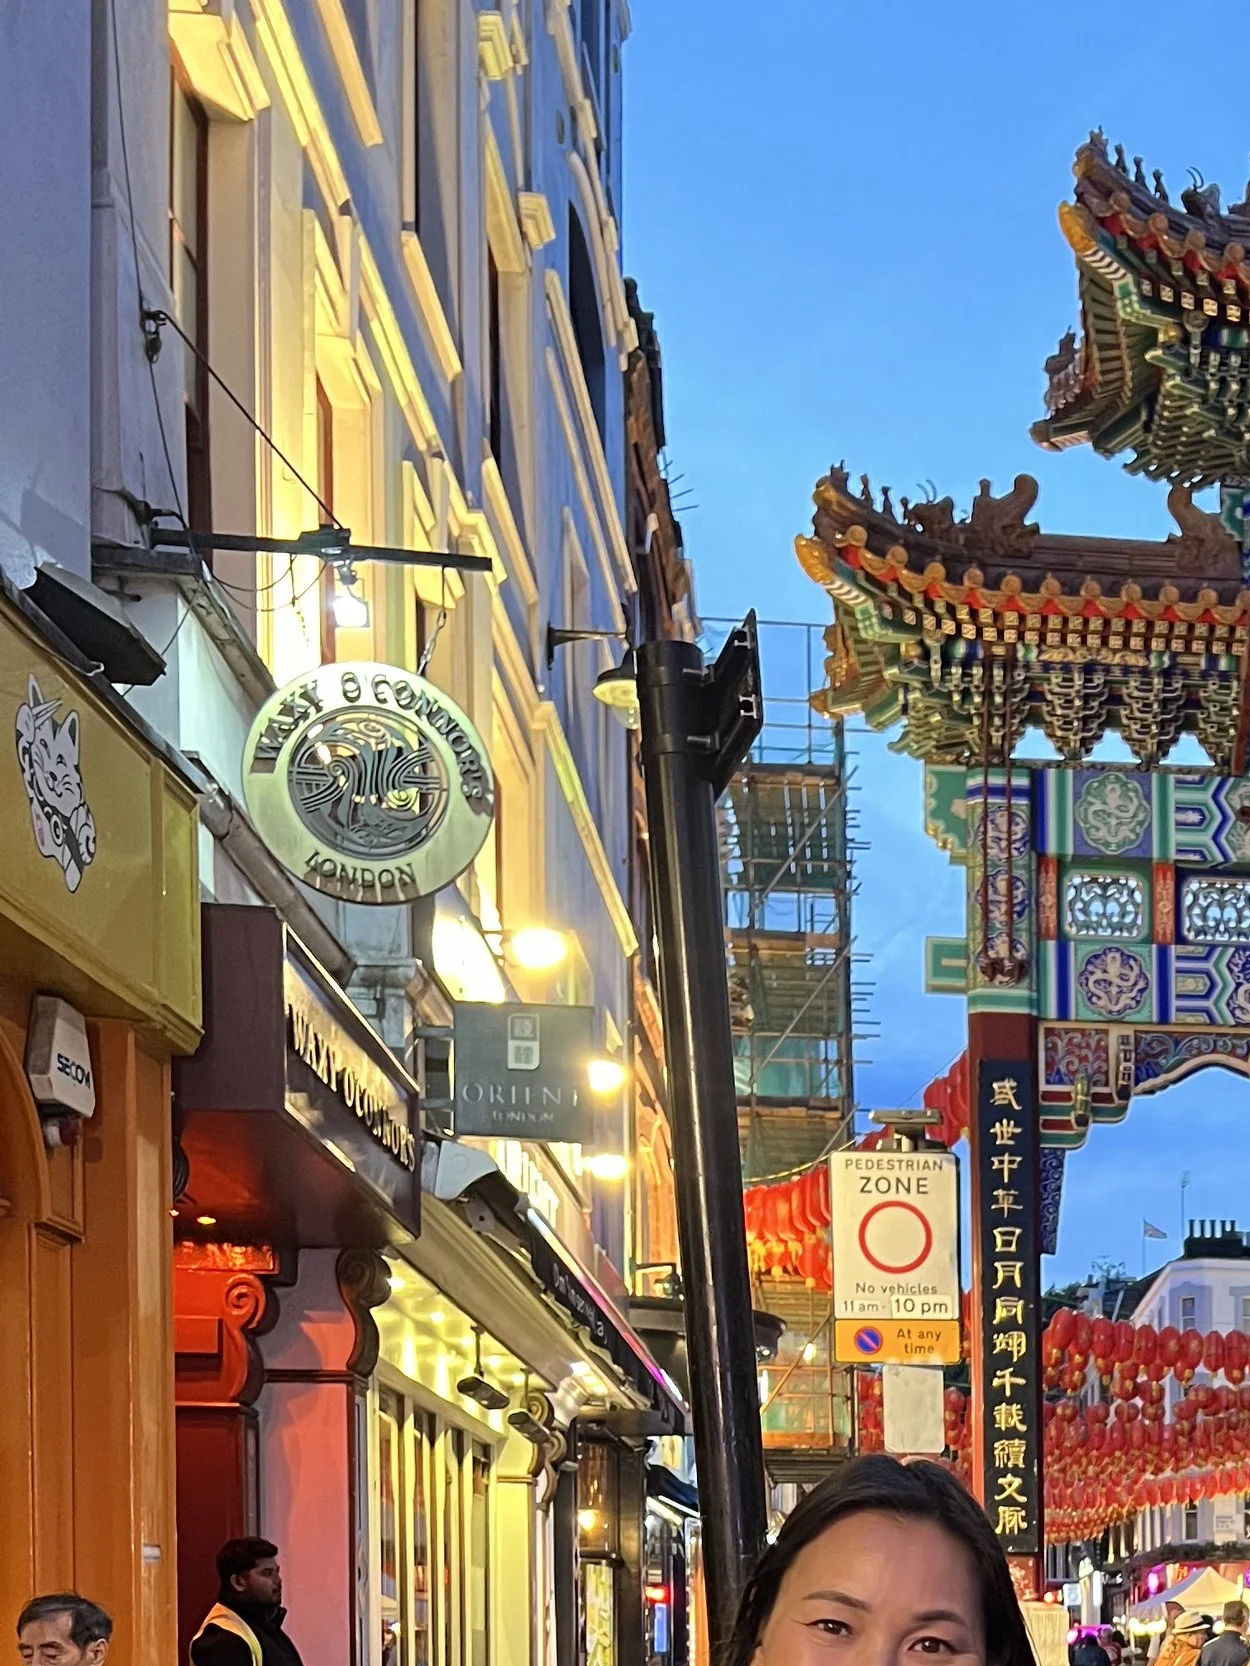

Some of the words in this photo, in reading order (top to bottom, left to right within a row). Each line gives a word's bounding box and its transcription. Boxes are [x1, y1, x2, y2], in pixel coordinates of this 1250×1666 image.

[254, 679, 324, 759] WAXY
[304, 849, 416, 889] LONDON
[845, 1158, 943, 1172] PEDESTRIAN
[859, 1176, 929, 1195] ZONE
[855, 1282, 876, 1295] No
[880, 1282, 938, 1296] vehicles
[894, 1298, 915, 1313] 10
[921, 1301, 949, 1315] pm
[896, 1328, 912, 1340] At
[918, 1329, 943, 1342] any
[904, 1343, 935, 1354] time
